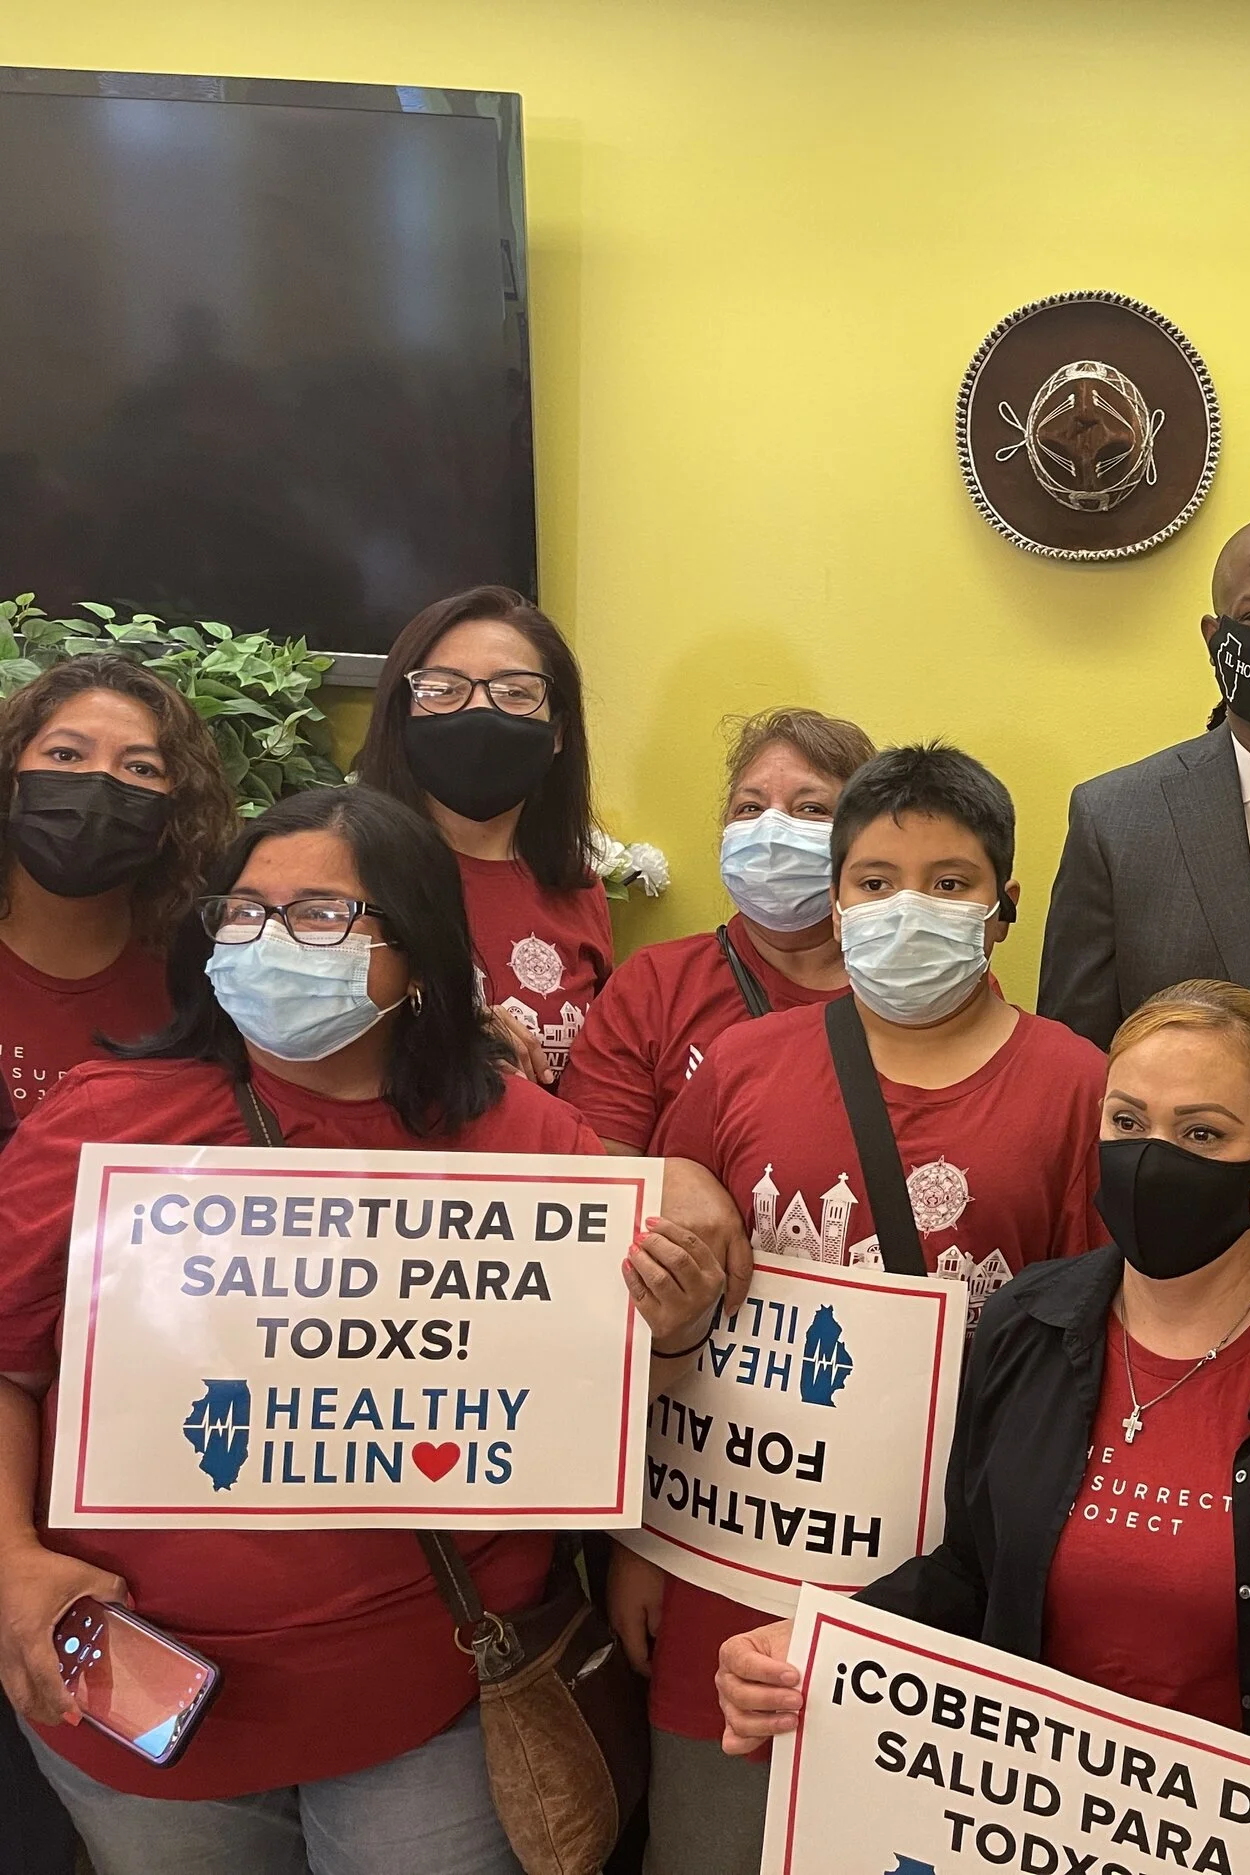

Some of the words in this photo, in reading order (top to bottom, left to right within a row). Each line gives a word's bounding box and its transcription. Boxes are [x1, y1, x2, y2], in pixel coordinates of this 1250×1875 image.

[1224, 650, 1235, 669] IL
[130, 1193, 514, 1246] ¡COBERTURA
[534, 1202, 608, 1243] DE
[180, 1255, 378, 1298] SALUD
[399, 1258, 551, 1301] PARA
[256, 1317, 470, 1361] TODXS!
[265, 1386, 531, 1431] HEALTHY
[726, 1421, 826, 1483] FOR
[831, 1660, 1198, 1810] ¡COBERTURA
[874, 1730, 1062, 1817] SALUD
[1080, 1793, 1232, 1875] PARA
